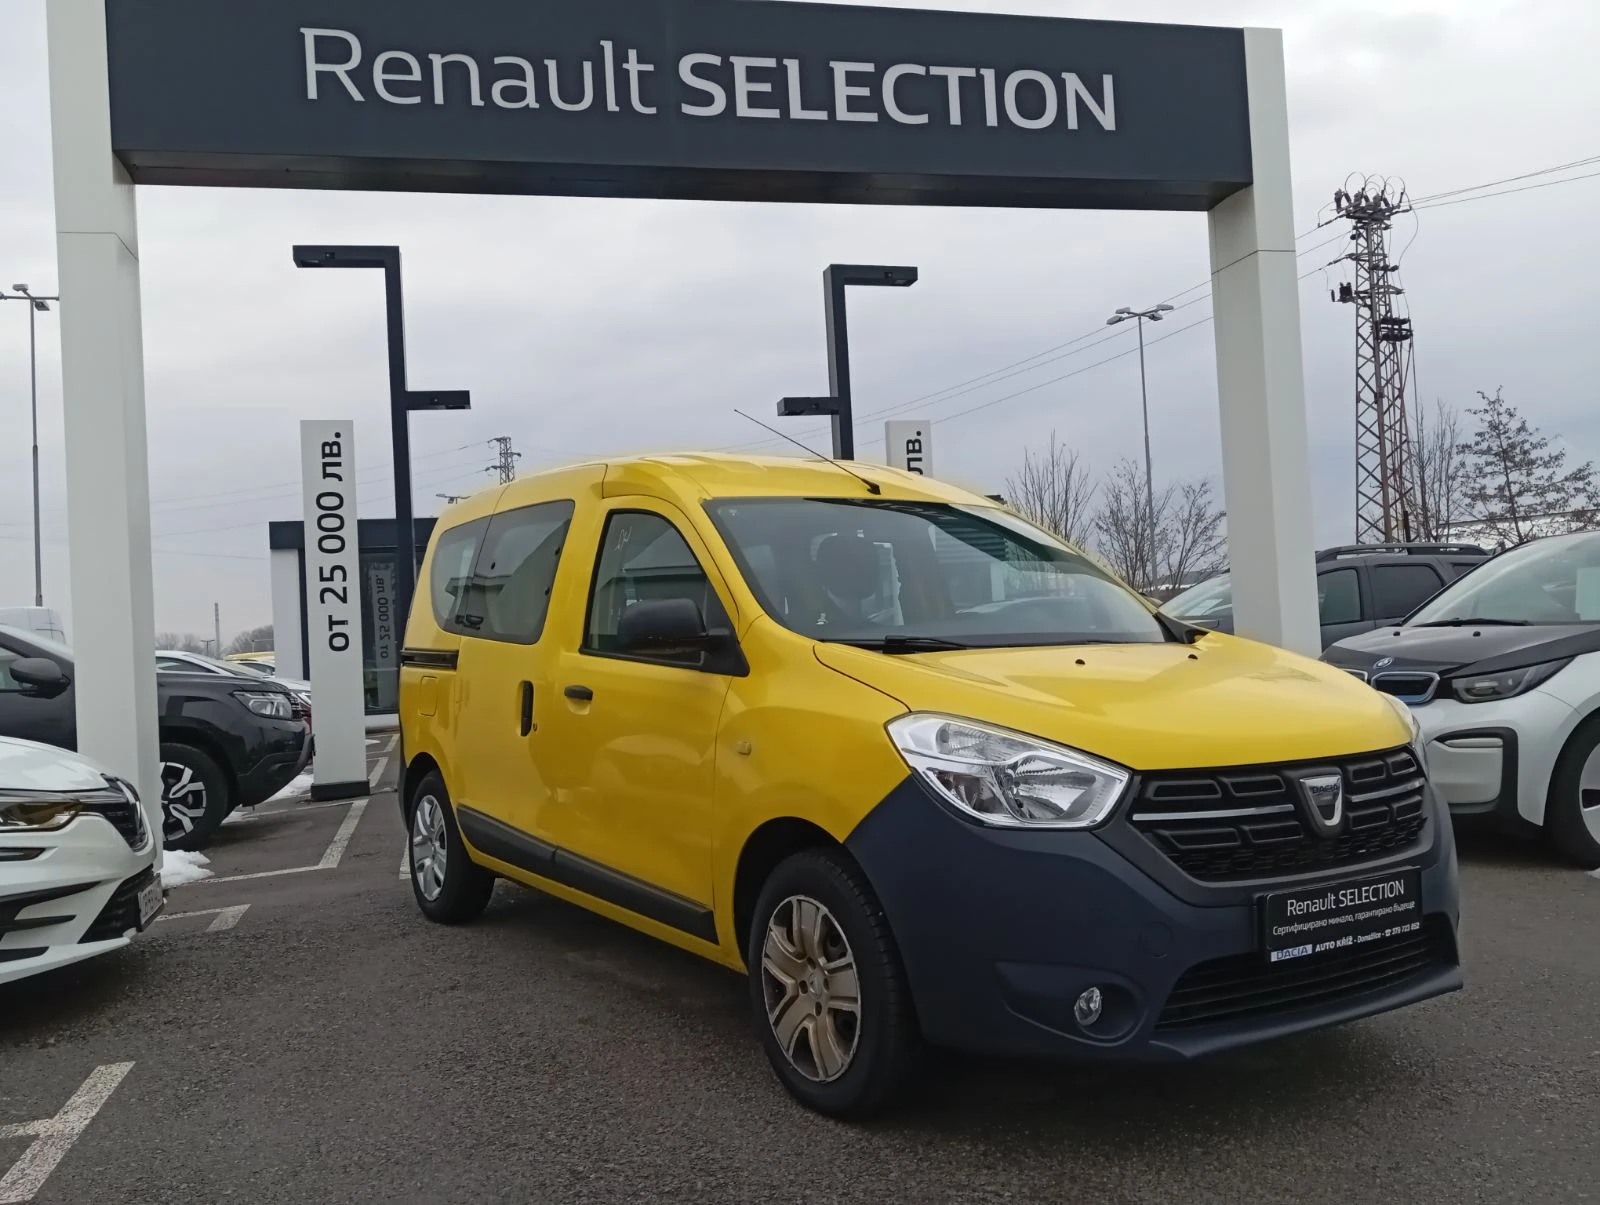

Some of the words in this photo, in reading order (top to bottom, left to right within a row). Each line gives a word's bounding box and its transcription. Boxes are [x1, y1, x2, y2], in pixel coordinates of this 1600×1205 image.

[300, 27, 657, 115] Renault
[678, 52, 1116, 131] SELECTION
[321, 431, 344, 482] лв.
[315, 491, 346, 554] 000
[319, 565, 347, 605] 25
[328, 615, 350, 652] от
[1287, 892, 1336, 916] Renault
[1339, 879, 1405, 907] SELECTION
[1273, 918, 1328, 936] Сертифицирано
[1276, 946, 1309, 960] DACIA
[1315, 941, 1335, 952] AUTO
